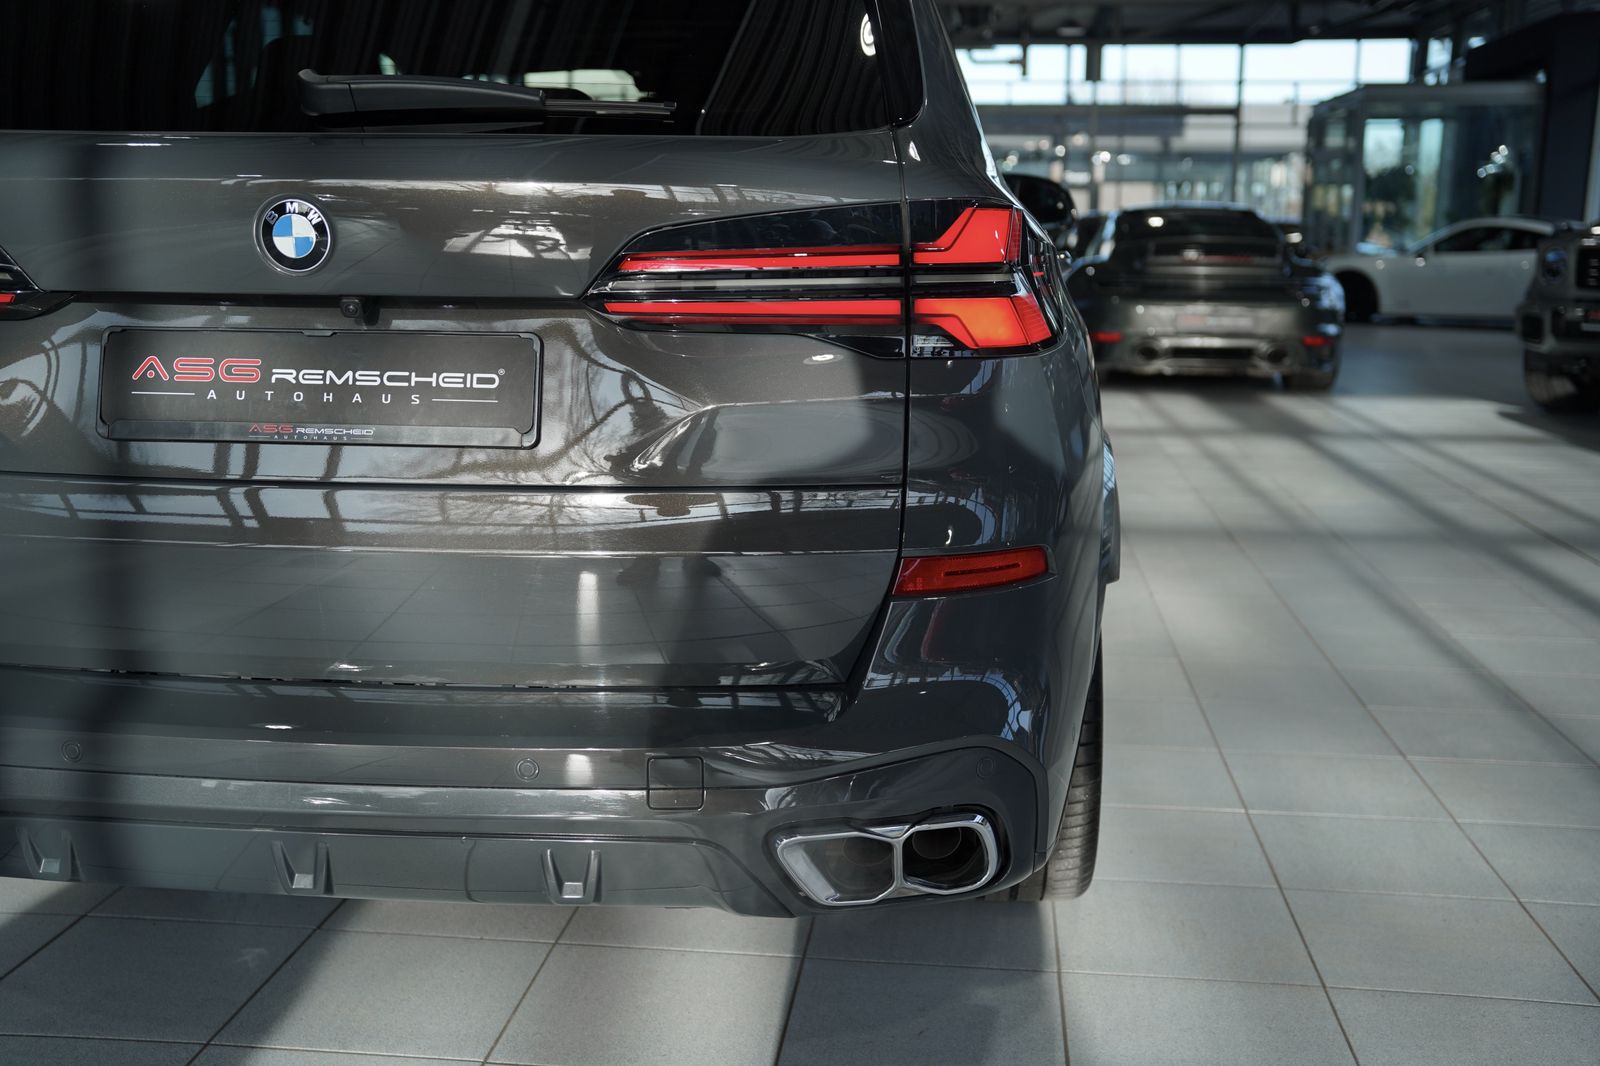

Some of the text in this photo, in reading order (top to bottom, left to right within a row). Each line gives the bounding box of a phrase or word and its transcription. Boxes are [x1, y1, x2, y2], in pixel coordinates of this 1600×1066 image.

[265, 202, 322, 226] BMW
[132, 355, 262, 383] ASG
[207, 389, 420, 405] AUTOHAUS
[248, 423, 294, 434] ASG
